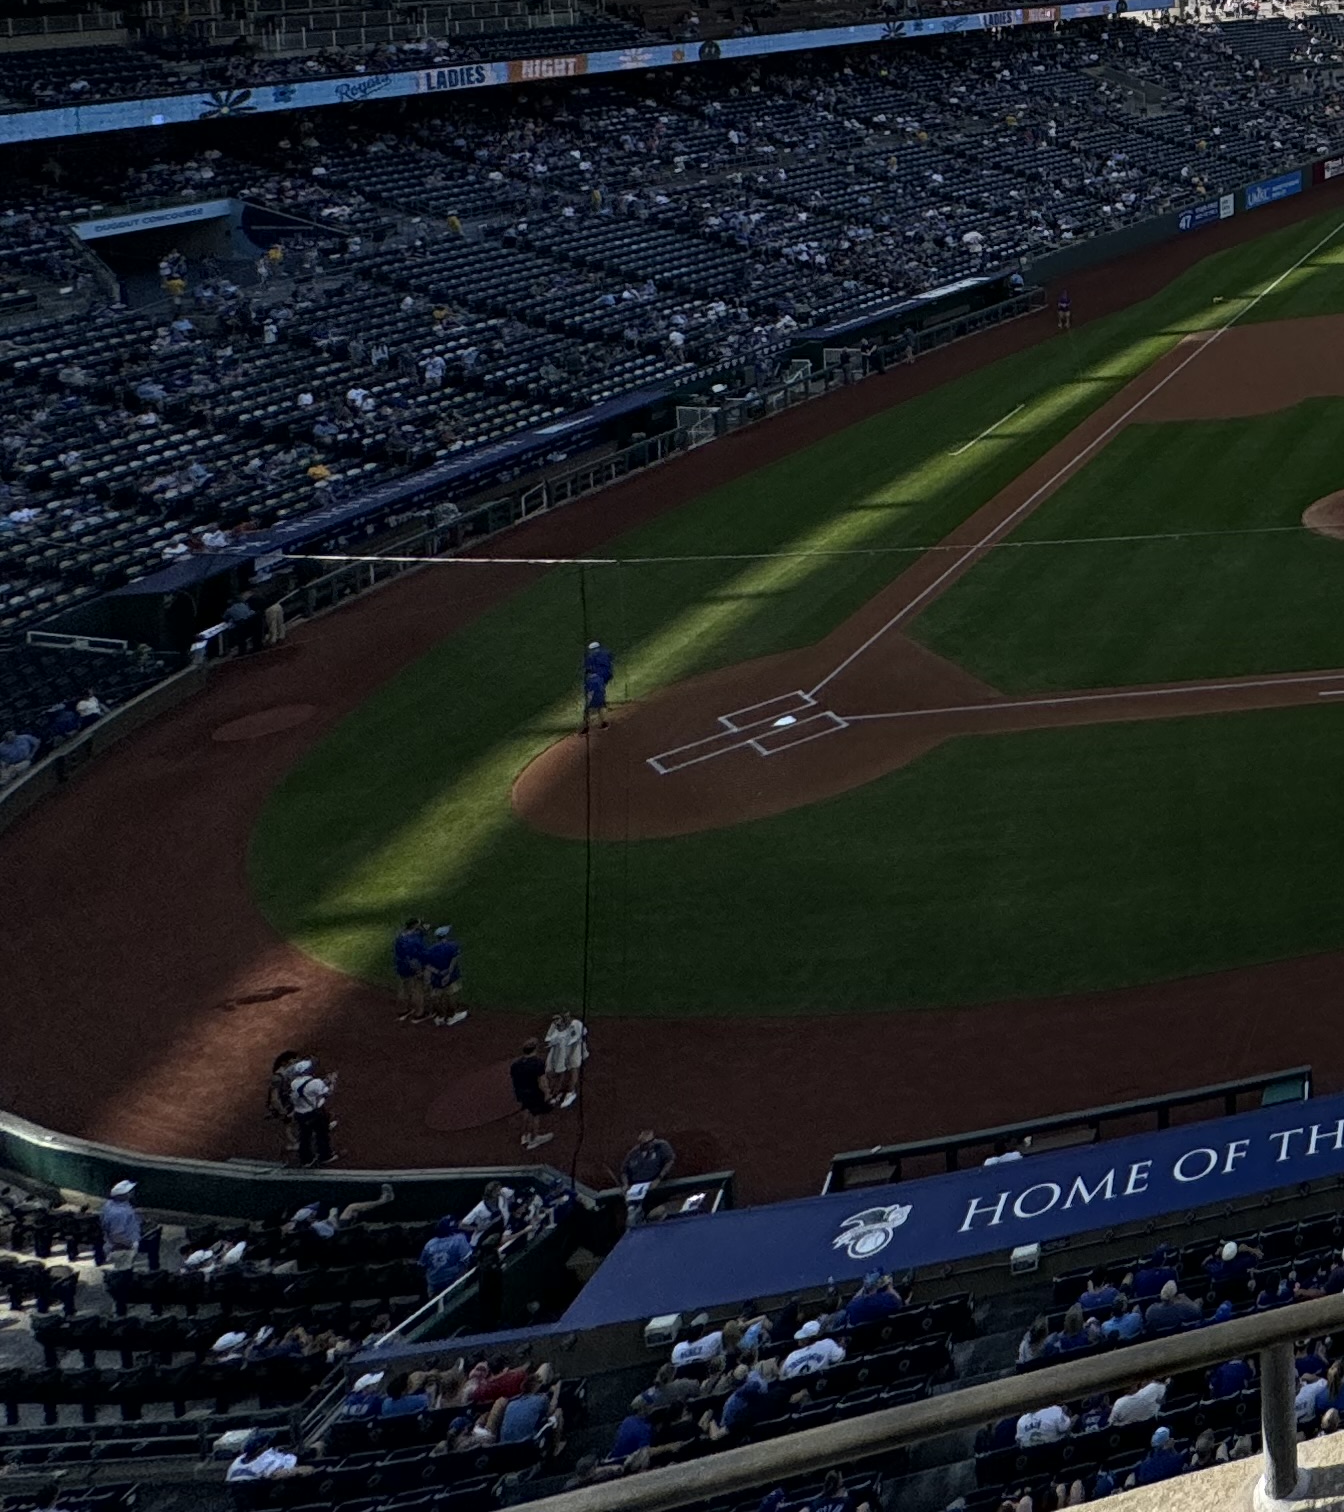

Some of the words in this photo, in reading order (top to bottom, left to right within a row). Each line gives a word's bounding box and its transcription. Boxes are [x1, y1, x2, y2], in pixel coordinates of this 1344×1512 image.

[983, 11, 1014, 29] LADIES
[334, 75, 392, 102] Royals
[426, 65, 486, 90] LADIES
[522, 58, 578, 79] NIGHT
[95, 218, 139, 233] DUGOUT
[142, 208, 204, 224] CONCOURSE
[957, 1159, 1152, 1234] HOME
[1173, 1139, 1250, 1183] OF
